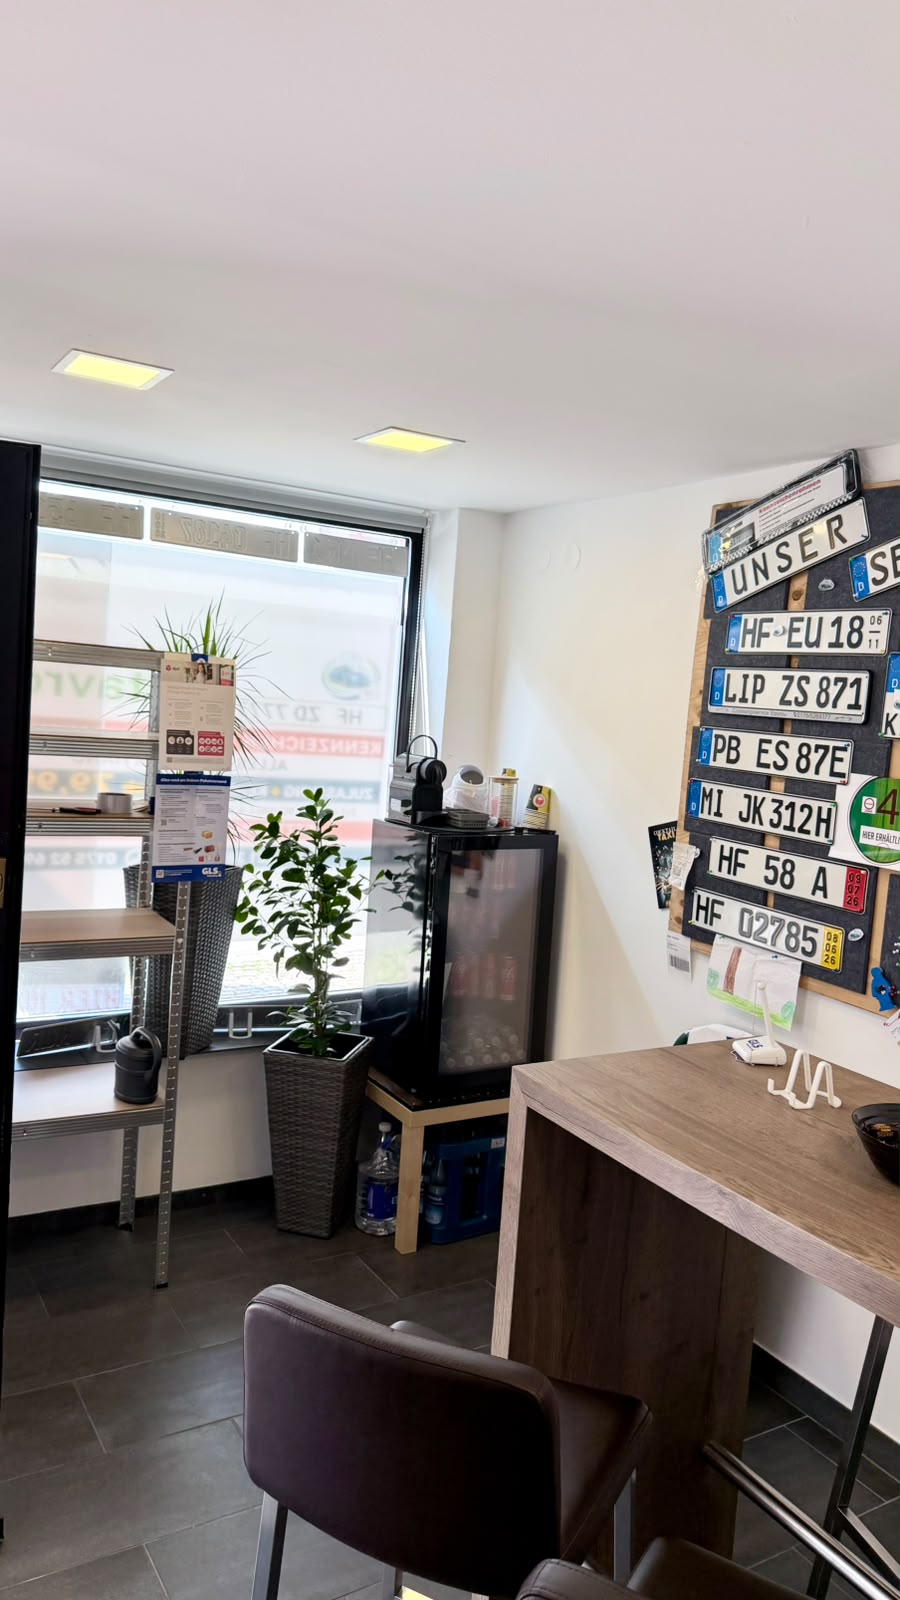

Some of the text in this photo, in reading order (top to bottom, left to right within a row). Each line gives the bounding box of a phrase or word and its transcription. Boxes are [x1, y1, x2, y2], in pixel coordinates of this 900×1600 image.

[731, 514, 847, 595] UNSER
[857, 543, 900, 592] D SE
[869, 615, 882, 625] 06
[741, 617, 774, 648] HF
[787, 617, 823, 648] EU
[828, 615, 864, 649] 18
[868, 638, 879, 649] 11
[891, 678, 899, 689] D
[714, 673, 862, 710] D LIP ZS 871
[701, 734, 848, 779] D PB ES 87E
[877, 788, 899, 825] 4
[691, 786, 832, 839] D MI JK 312H
[657, 831, 676, 841] TAXI
[862, 831, 875, 840] HIER
[202, 867, 219, 875] GLS
[718, 845, 749, 876] HF
[764, 855, 795, 889] 58
[811, 867, 828, 899] A
[848, 872, 861, 883] 09
[847, 884, 860, 895] 07
[846, 895, 859, 906] 26
[695, 894, 818, 957] HF 02785
[826, 931, 838, 943] 08
[825, 943, 837, 954] 06
[824, 954, 836, 965] 26
